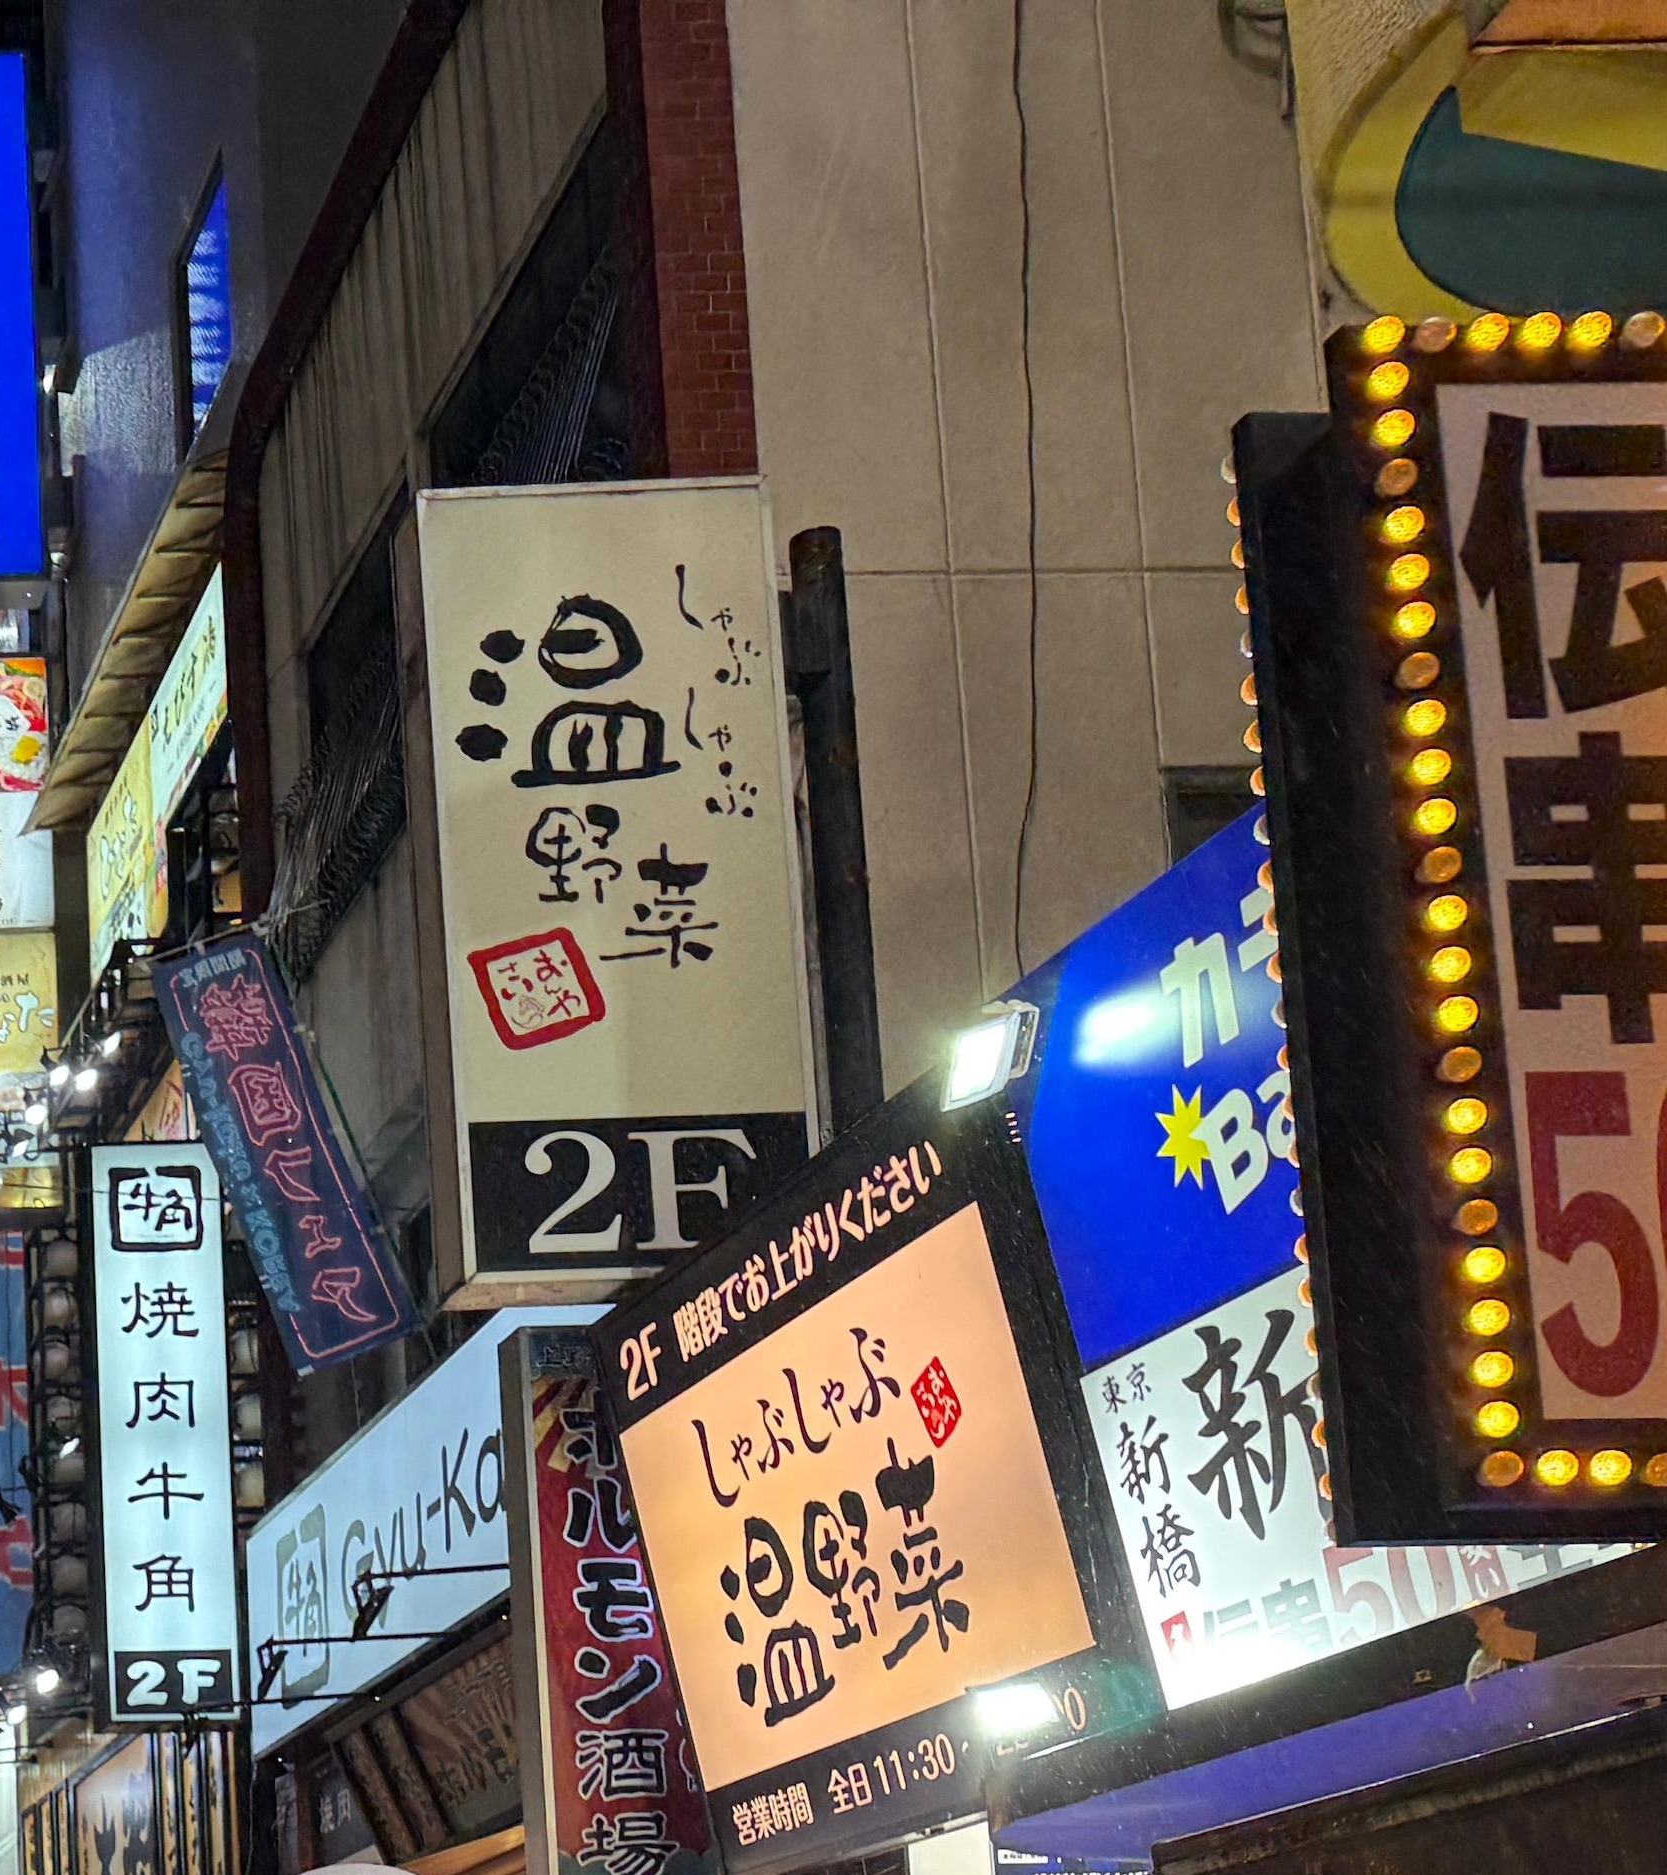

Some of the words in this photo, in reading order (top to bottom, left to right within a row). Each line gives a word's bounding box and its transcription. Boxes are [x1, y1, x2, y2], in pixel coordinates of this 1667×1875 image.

[454, 593, 718, 970] 温野菜
[674, 563, 764, 819] しゃぶしゃぶ
[119, 1181, 195, 1232] 牛角
[523, 1128, 760, 1254] 2F
[619, 1321, 665, 1403] 2F
[672, 1140, 943, 1364] 階段でお上がりください
[1525, 1070, 1667, 1398] 5
[118, 1280, 205, 1615] 焼肉牛角
[691, 1326, 902, 1509] しゃぶしゃぶ
[1101, 1362, 1153, 1415] 東京
[720, 1436, 971, 1728] 温野菜
[1116, 1414, 1201, 1599] 新橋
[126, 1657, 222, 1706] 2F
[732, 1781, 814, 1846] 営業時間
[827, 1763, 873, 1815] 全日
[873, 1733, 957, 1796] 11:30
